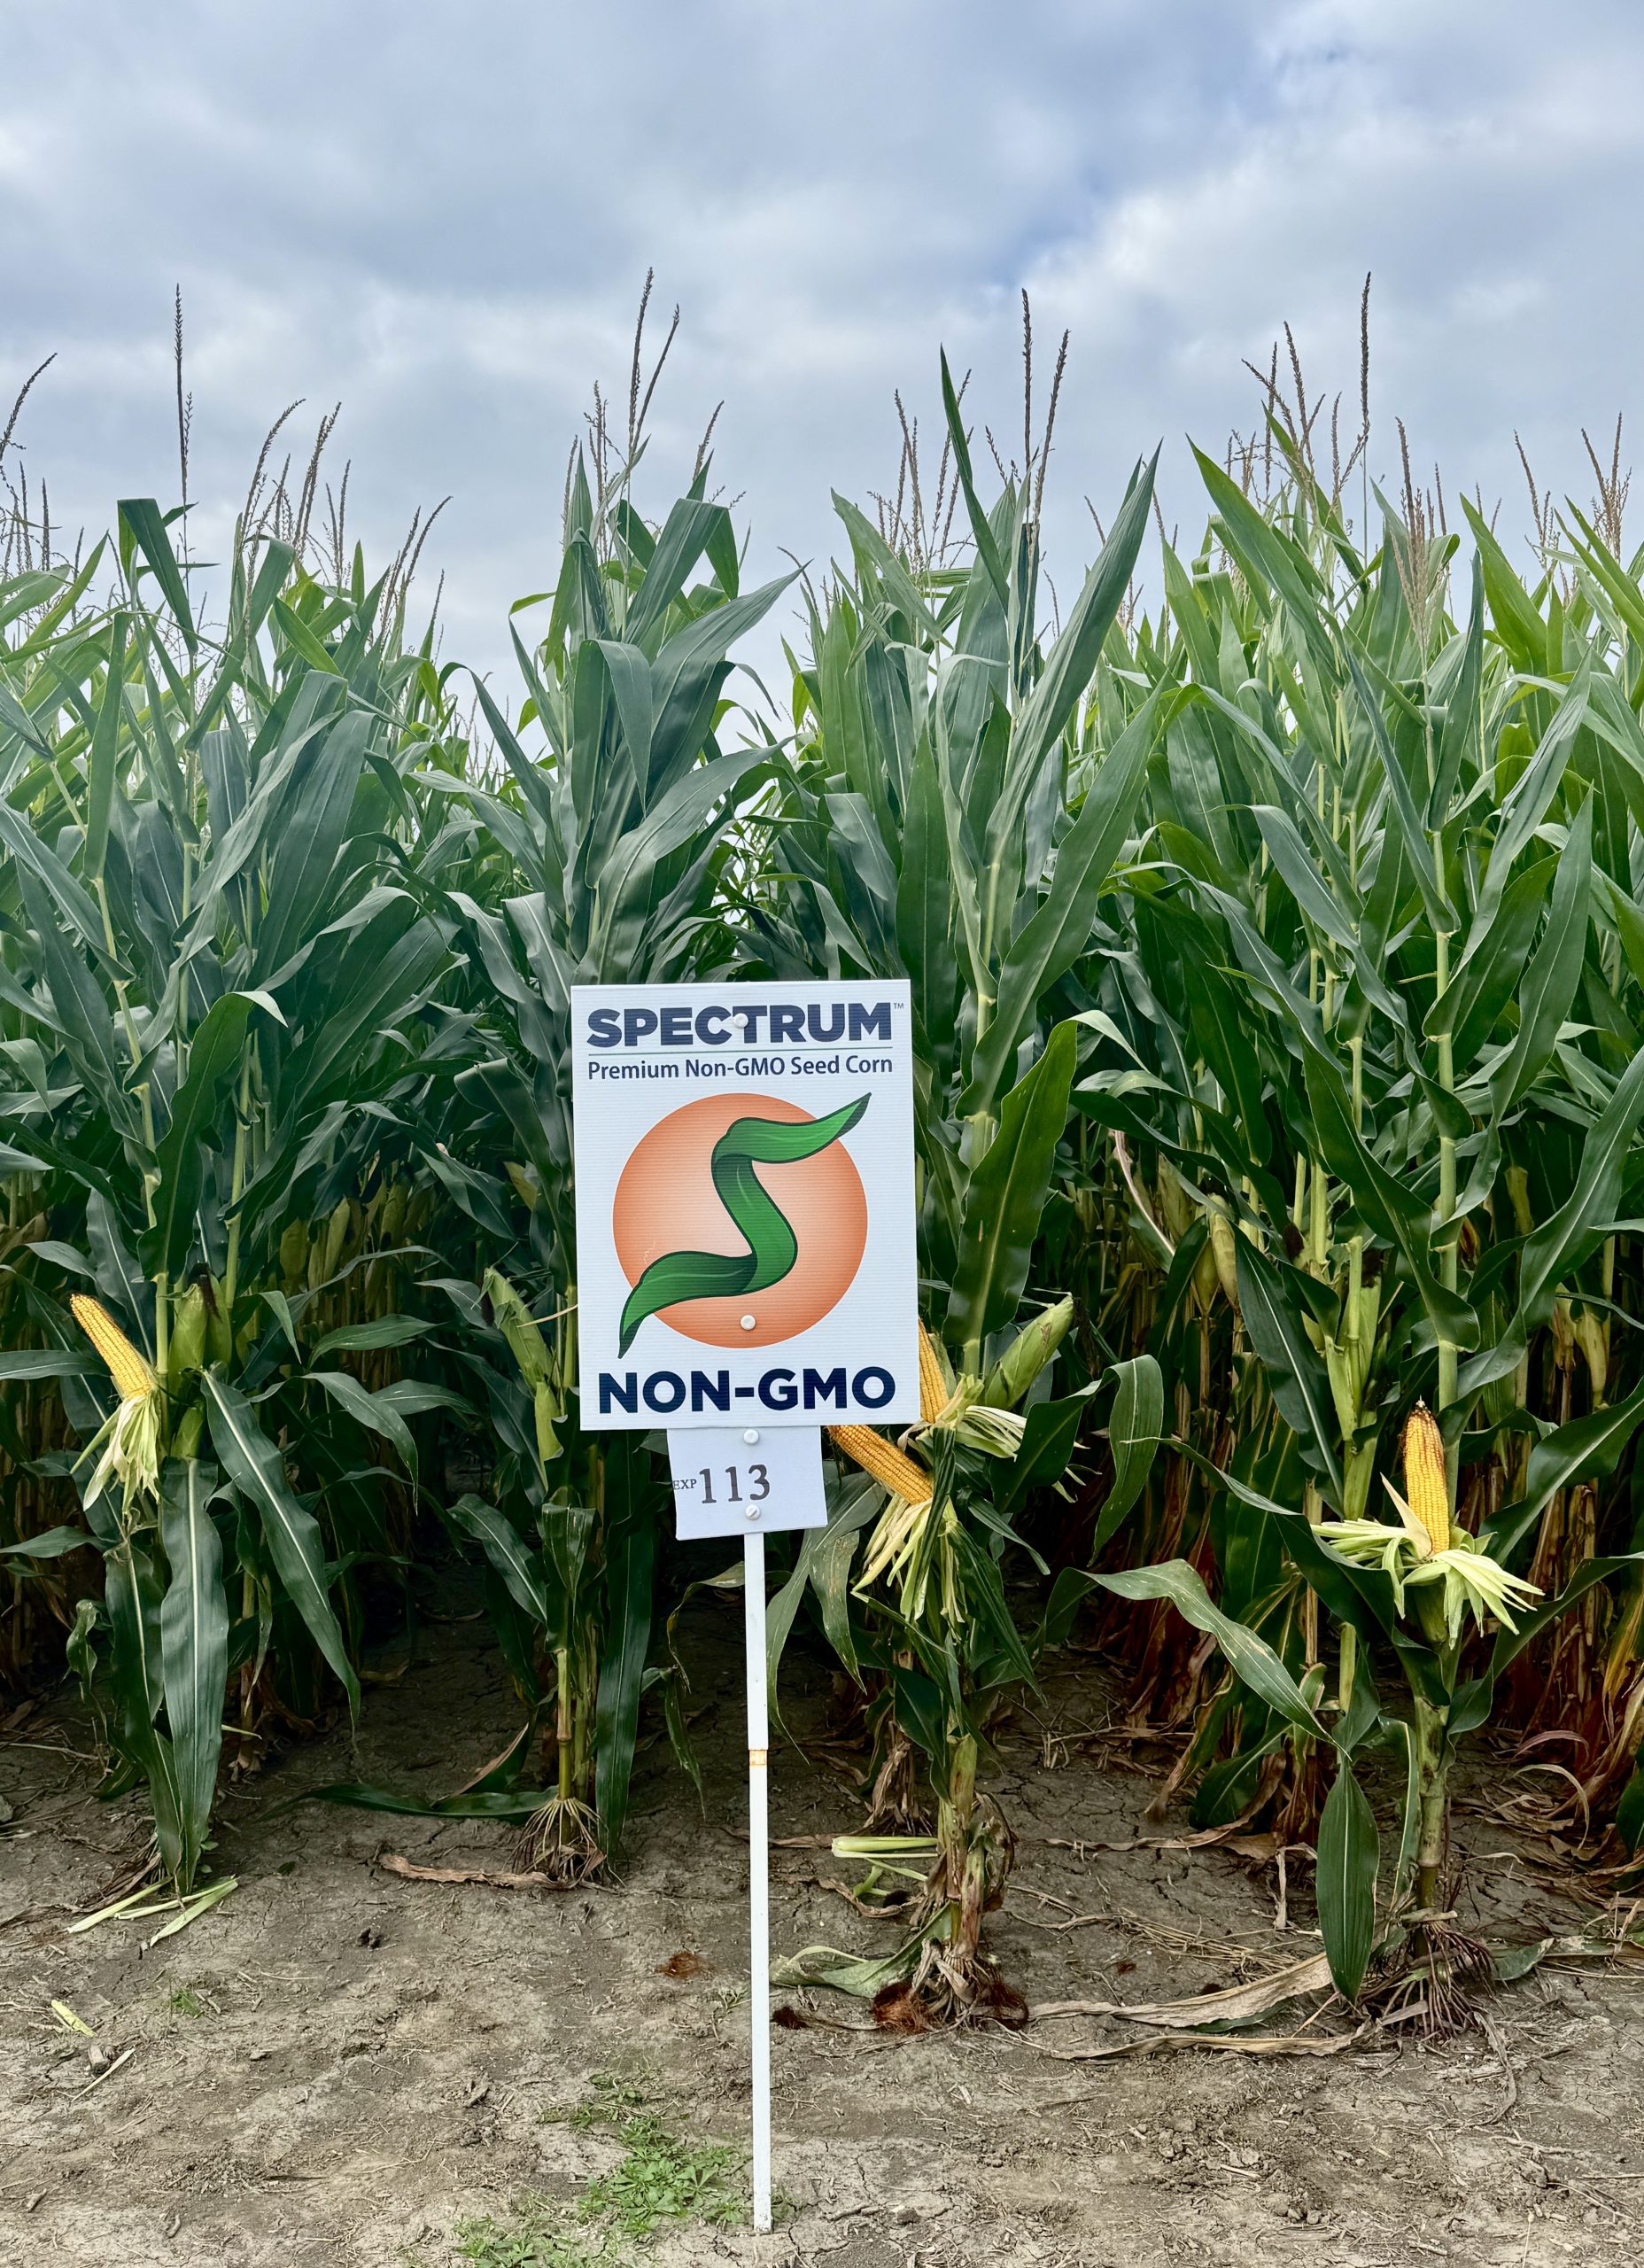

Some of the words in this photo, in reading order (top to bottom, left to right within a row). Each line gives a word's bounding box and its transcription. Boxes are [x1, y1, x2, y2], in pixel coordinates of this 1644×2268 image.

[586, 1003, 892, 1048] SPECTRUM
[588, 1061, 679, 1080] Premium
[686, 1057, 786, 1078] Non-GMO
[791, 1055, 840, 1075] Seed
[845, 1055, 893, 1074] Corn
[598, 1366, 896, 1414] NON-GMO
[672, 1479, 698, 1490] EXP
[699, 1464, 771, 1504] 113
